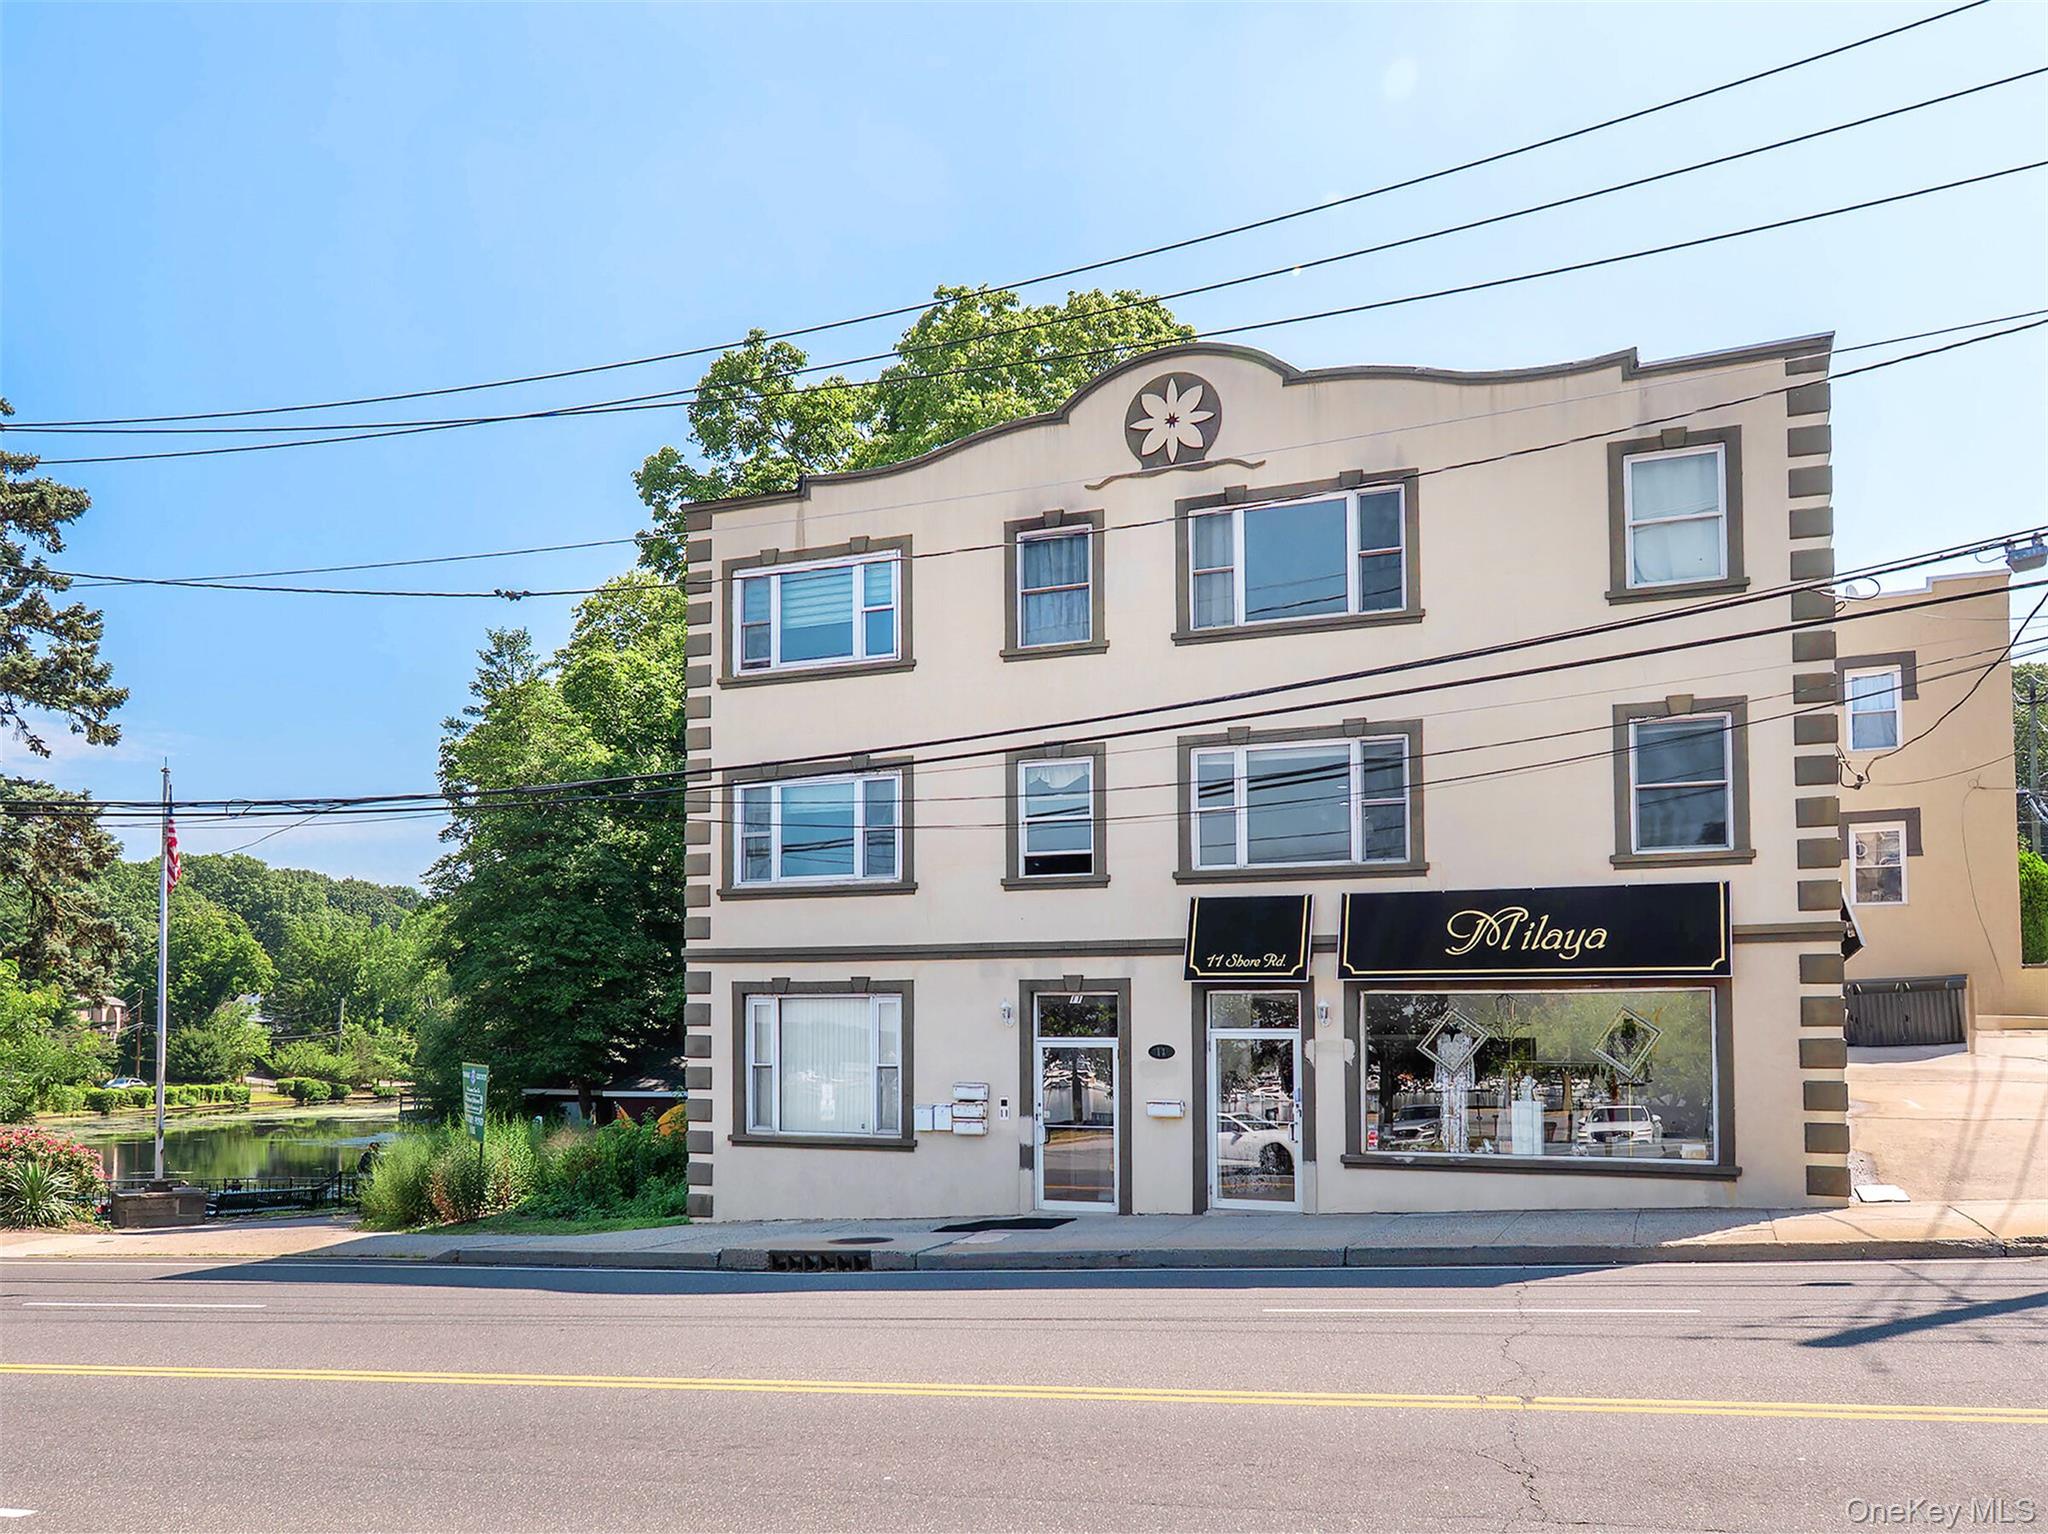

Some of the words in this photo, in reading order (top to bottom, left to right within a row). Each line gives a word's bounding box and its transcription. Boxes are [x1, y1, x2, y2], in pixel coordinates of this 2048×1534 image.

[1445, 906, 1608, 960] Milaya
[1206, 953, 1224, 968] 11
[1225, 953, 1261, 968] Shore
[1263, 953, 1287, 968] Rd.
